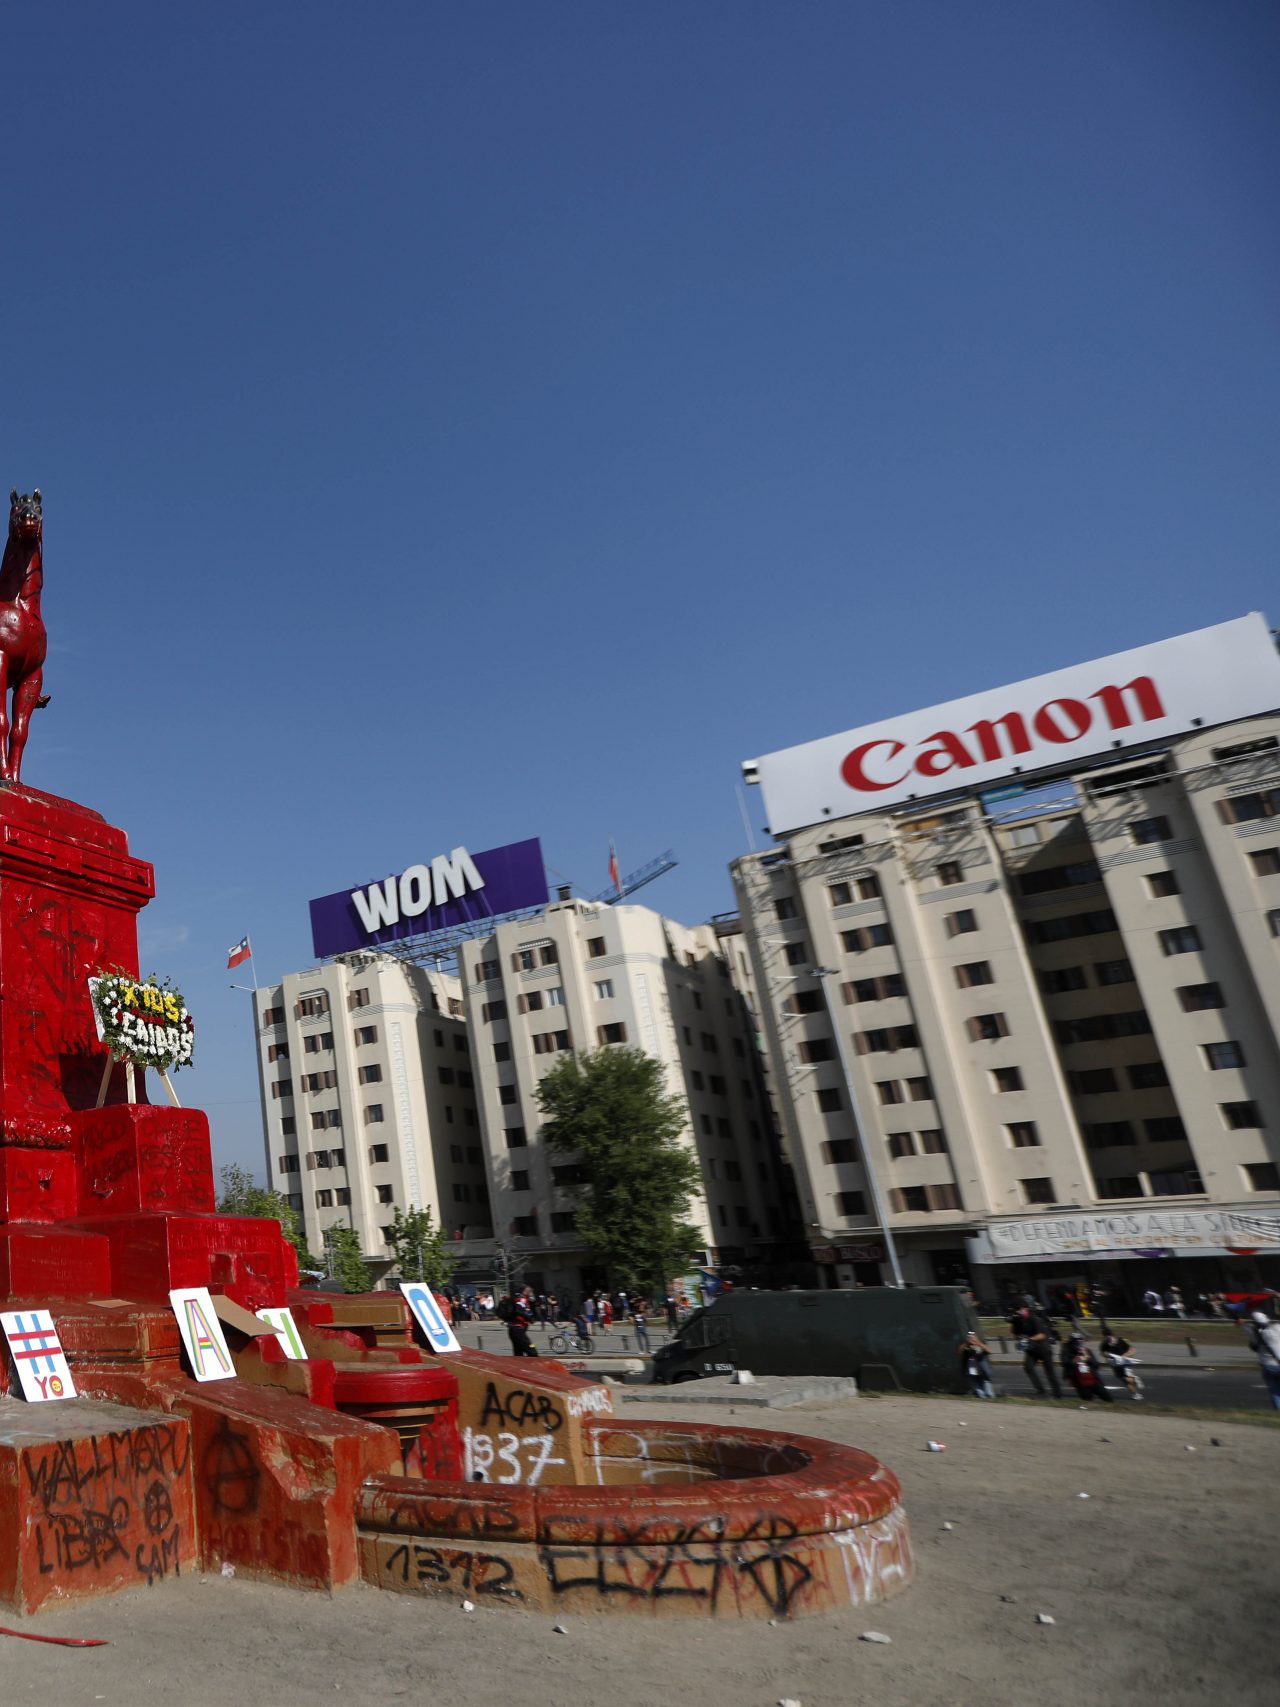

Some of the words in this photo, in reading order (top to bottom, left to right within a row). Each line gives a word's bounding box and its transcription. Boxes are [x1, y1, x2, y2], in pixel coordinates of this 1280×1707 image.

[840, 675, 1167, 792] Canon
[351, 846, 485, 934] WOM
[120, 984, 139, 1007] X
[184, 1299, 230, 1376] A
[34, 1375, 64, 1399] YO
[480, 1382, 562, 1430] ACAB
[385, 1544, 524, 1600] 1312
